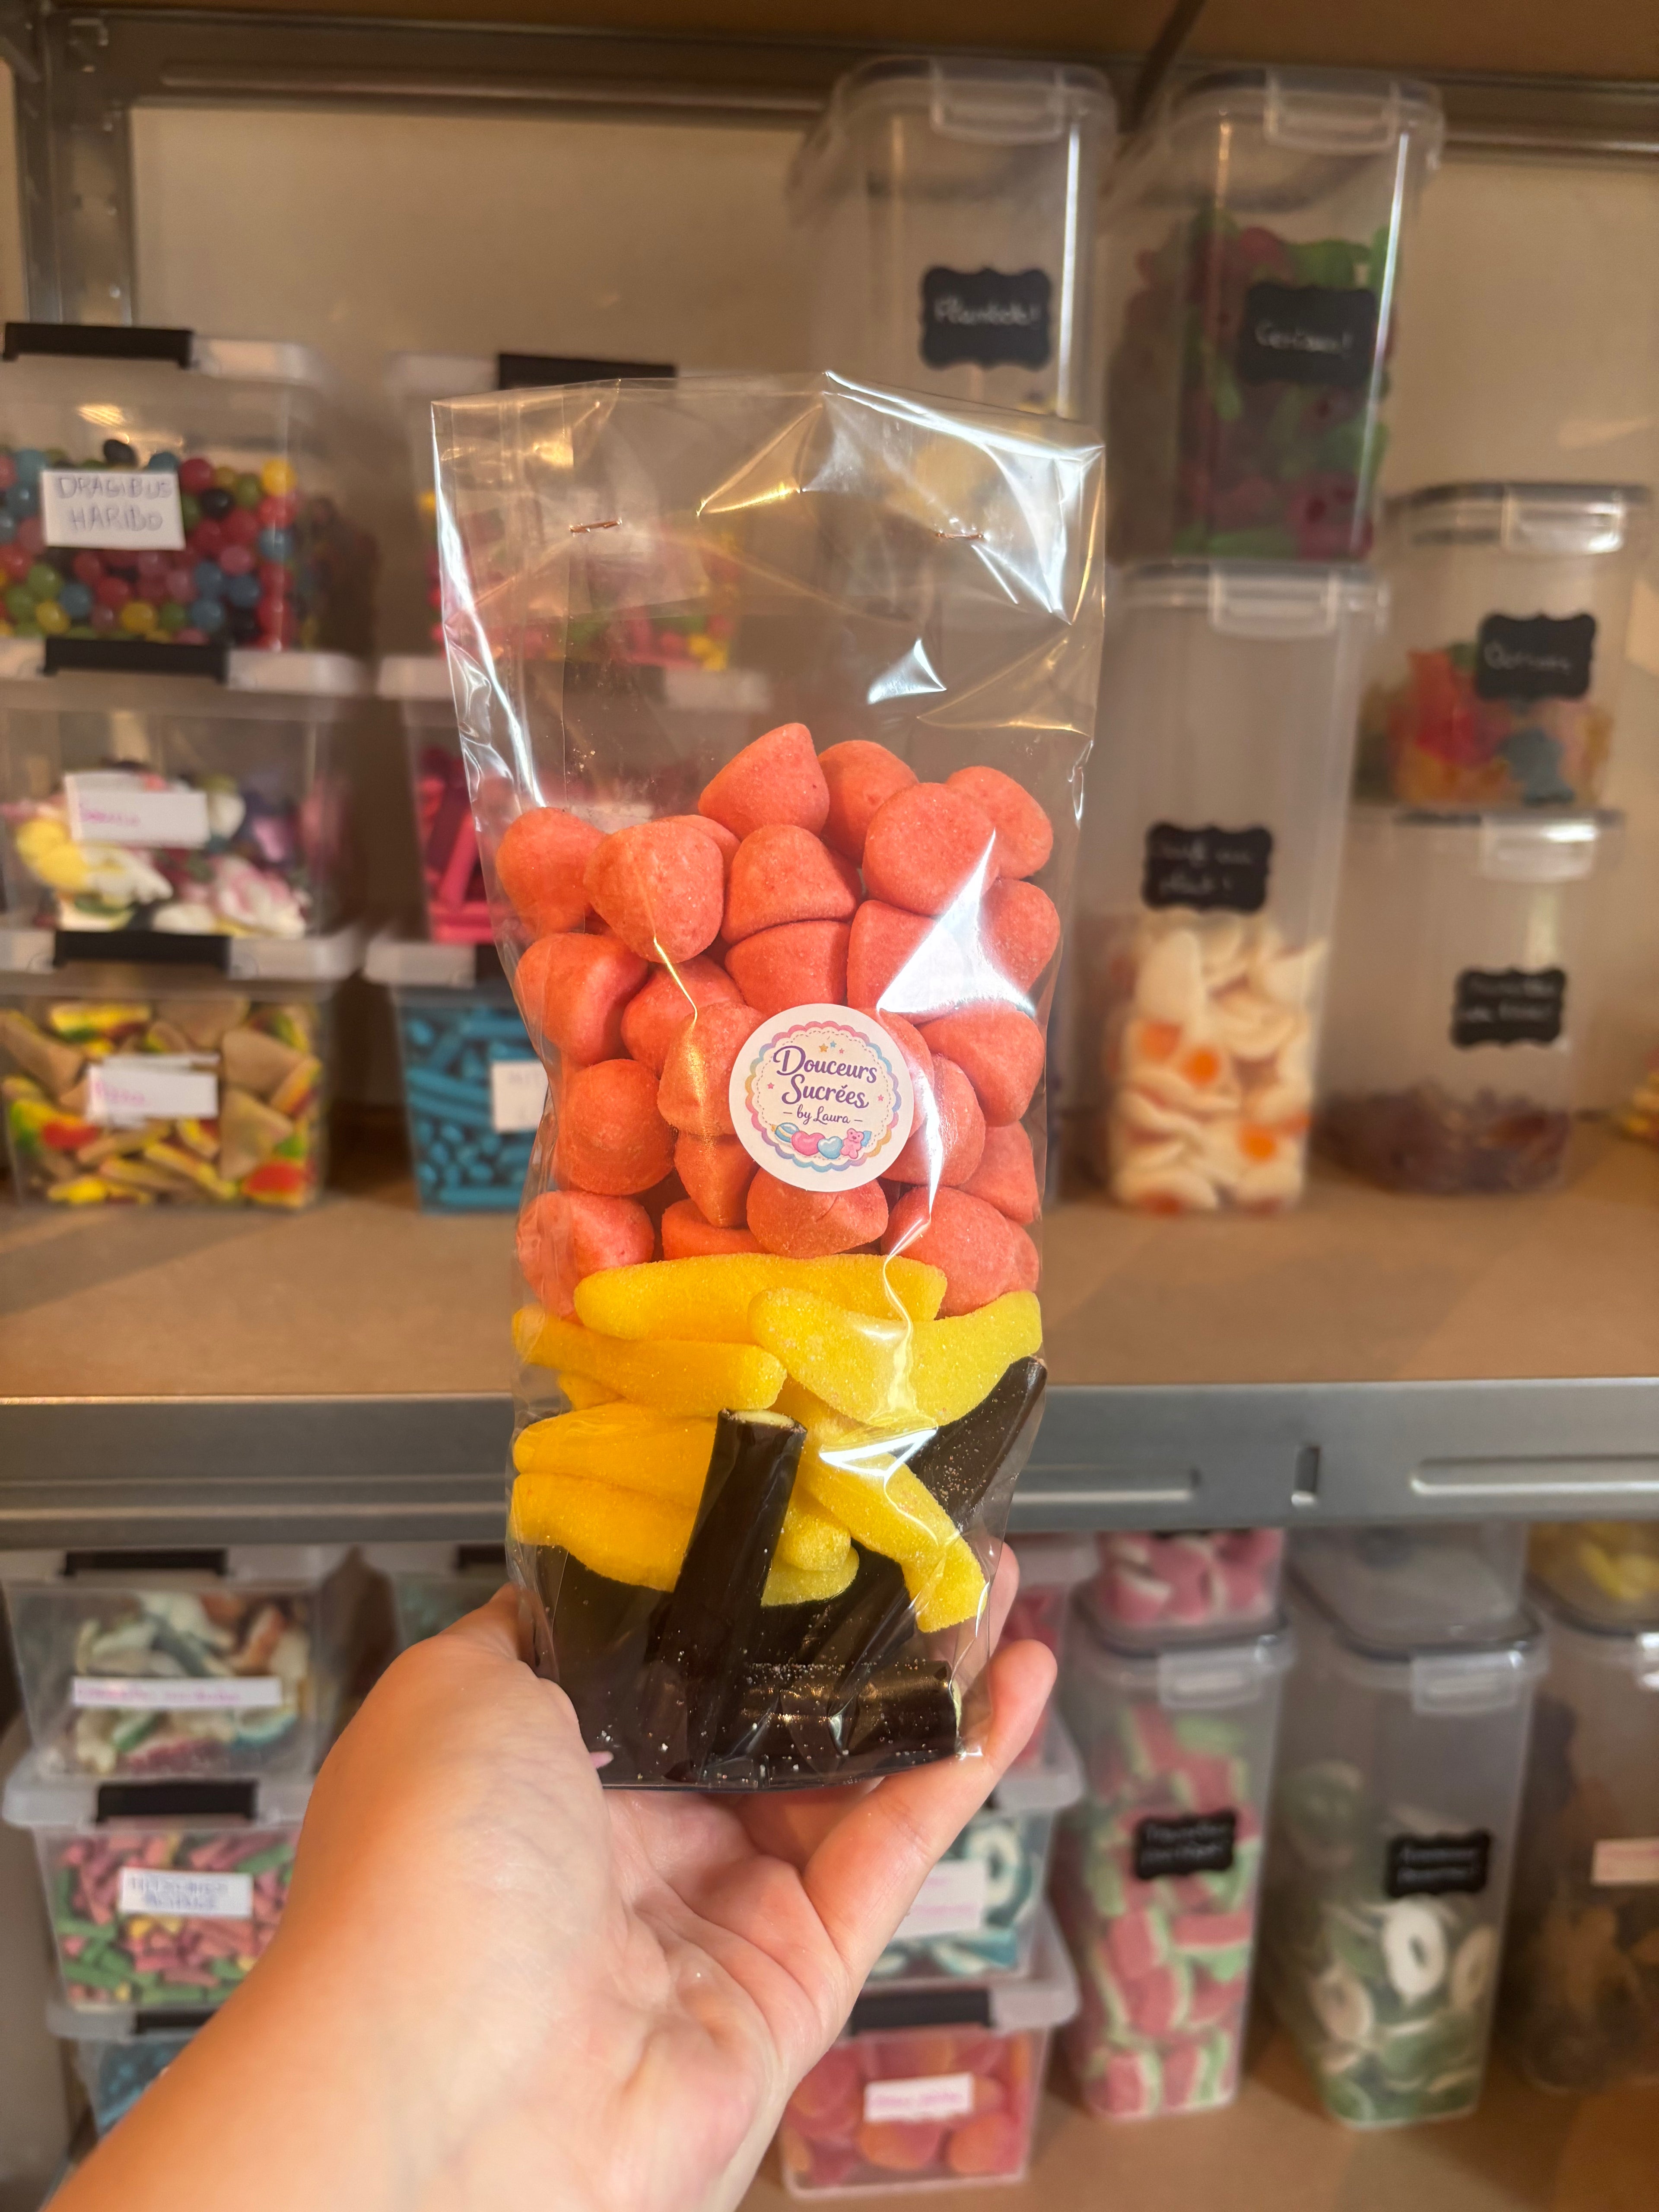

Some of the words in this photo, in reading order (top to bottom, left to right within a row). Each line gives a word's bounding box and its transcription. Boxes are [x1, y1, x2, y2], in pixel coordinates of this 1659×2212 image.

[57, 476, 173, 499] DRAGIBUS
[772, 1045, 877, 1084] Douceurs
[781, 1073, 870, 1109] Sucrées
[796, 1104, 812, 1125] by
[813, 1106, 851, 1125] Laura
